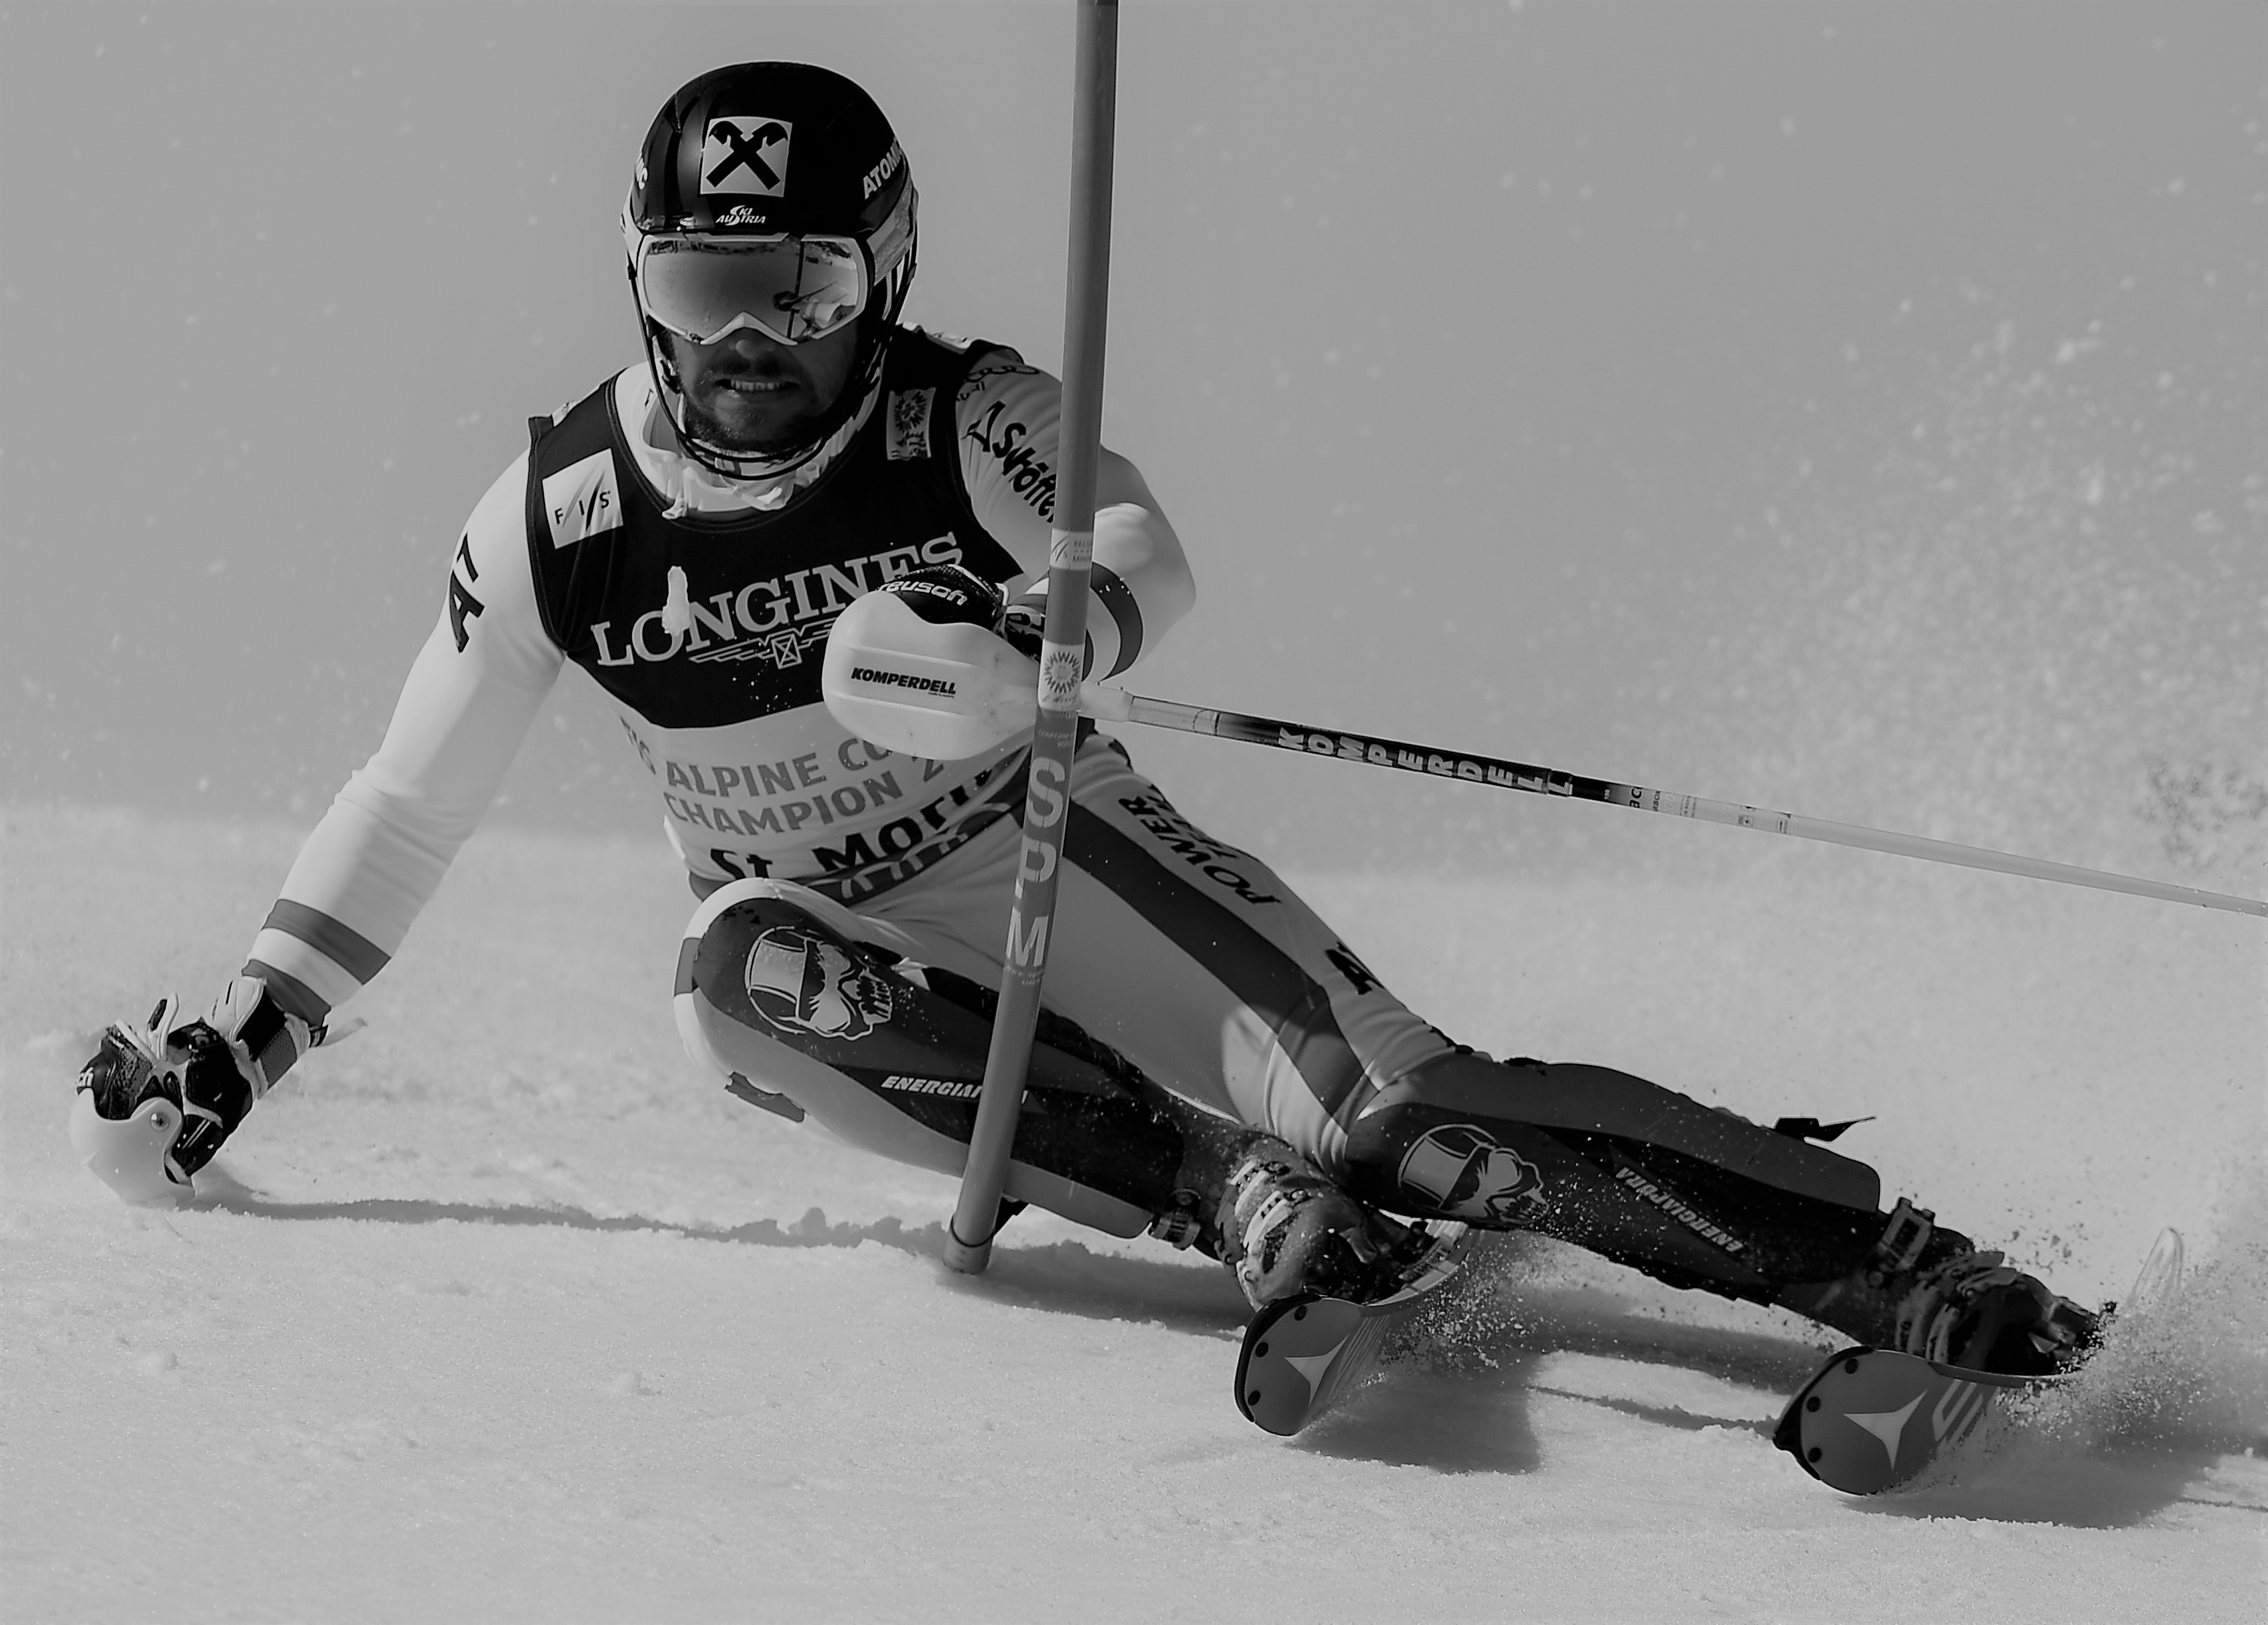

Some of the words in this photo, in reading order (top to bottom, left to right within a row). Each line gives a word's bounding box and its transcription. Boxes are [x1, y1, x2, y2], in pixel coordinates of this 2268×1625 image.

[715, 213, 766, 225] AUSTRIA
[554, 491, 611, 524] FIS
[590, 532, 963, 666] LONGINES
[851, 667, 956, 695] KOMPERDELL
[666, 752, 827, 797] ALPINE
[1278, 727, 1573, 798] KOMPERDELL
[663, 771, 903, 835] CHAMPION
[1118, 797, 1282, 905] POWER
[881, 1075, 1029, 1104] ENERGIA
[1615, 1167, 1743, 1252] ENERGIAPURA
